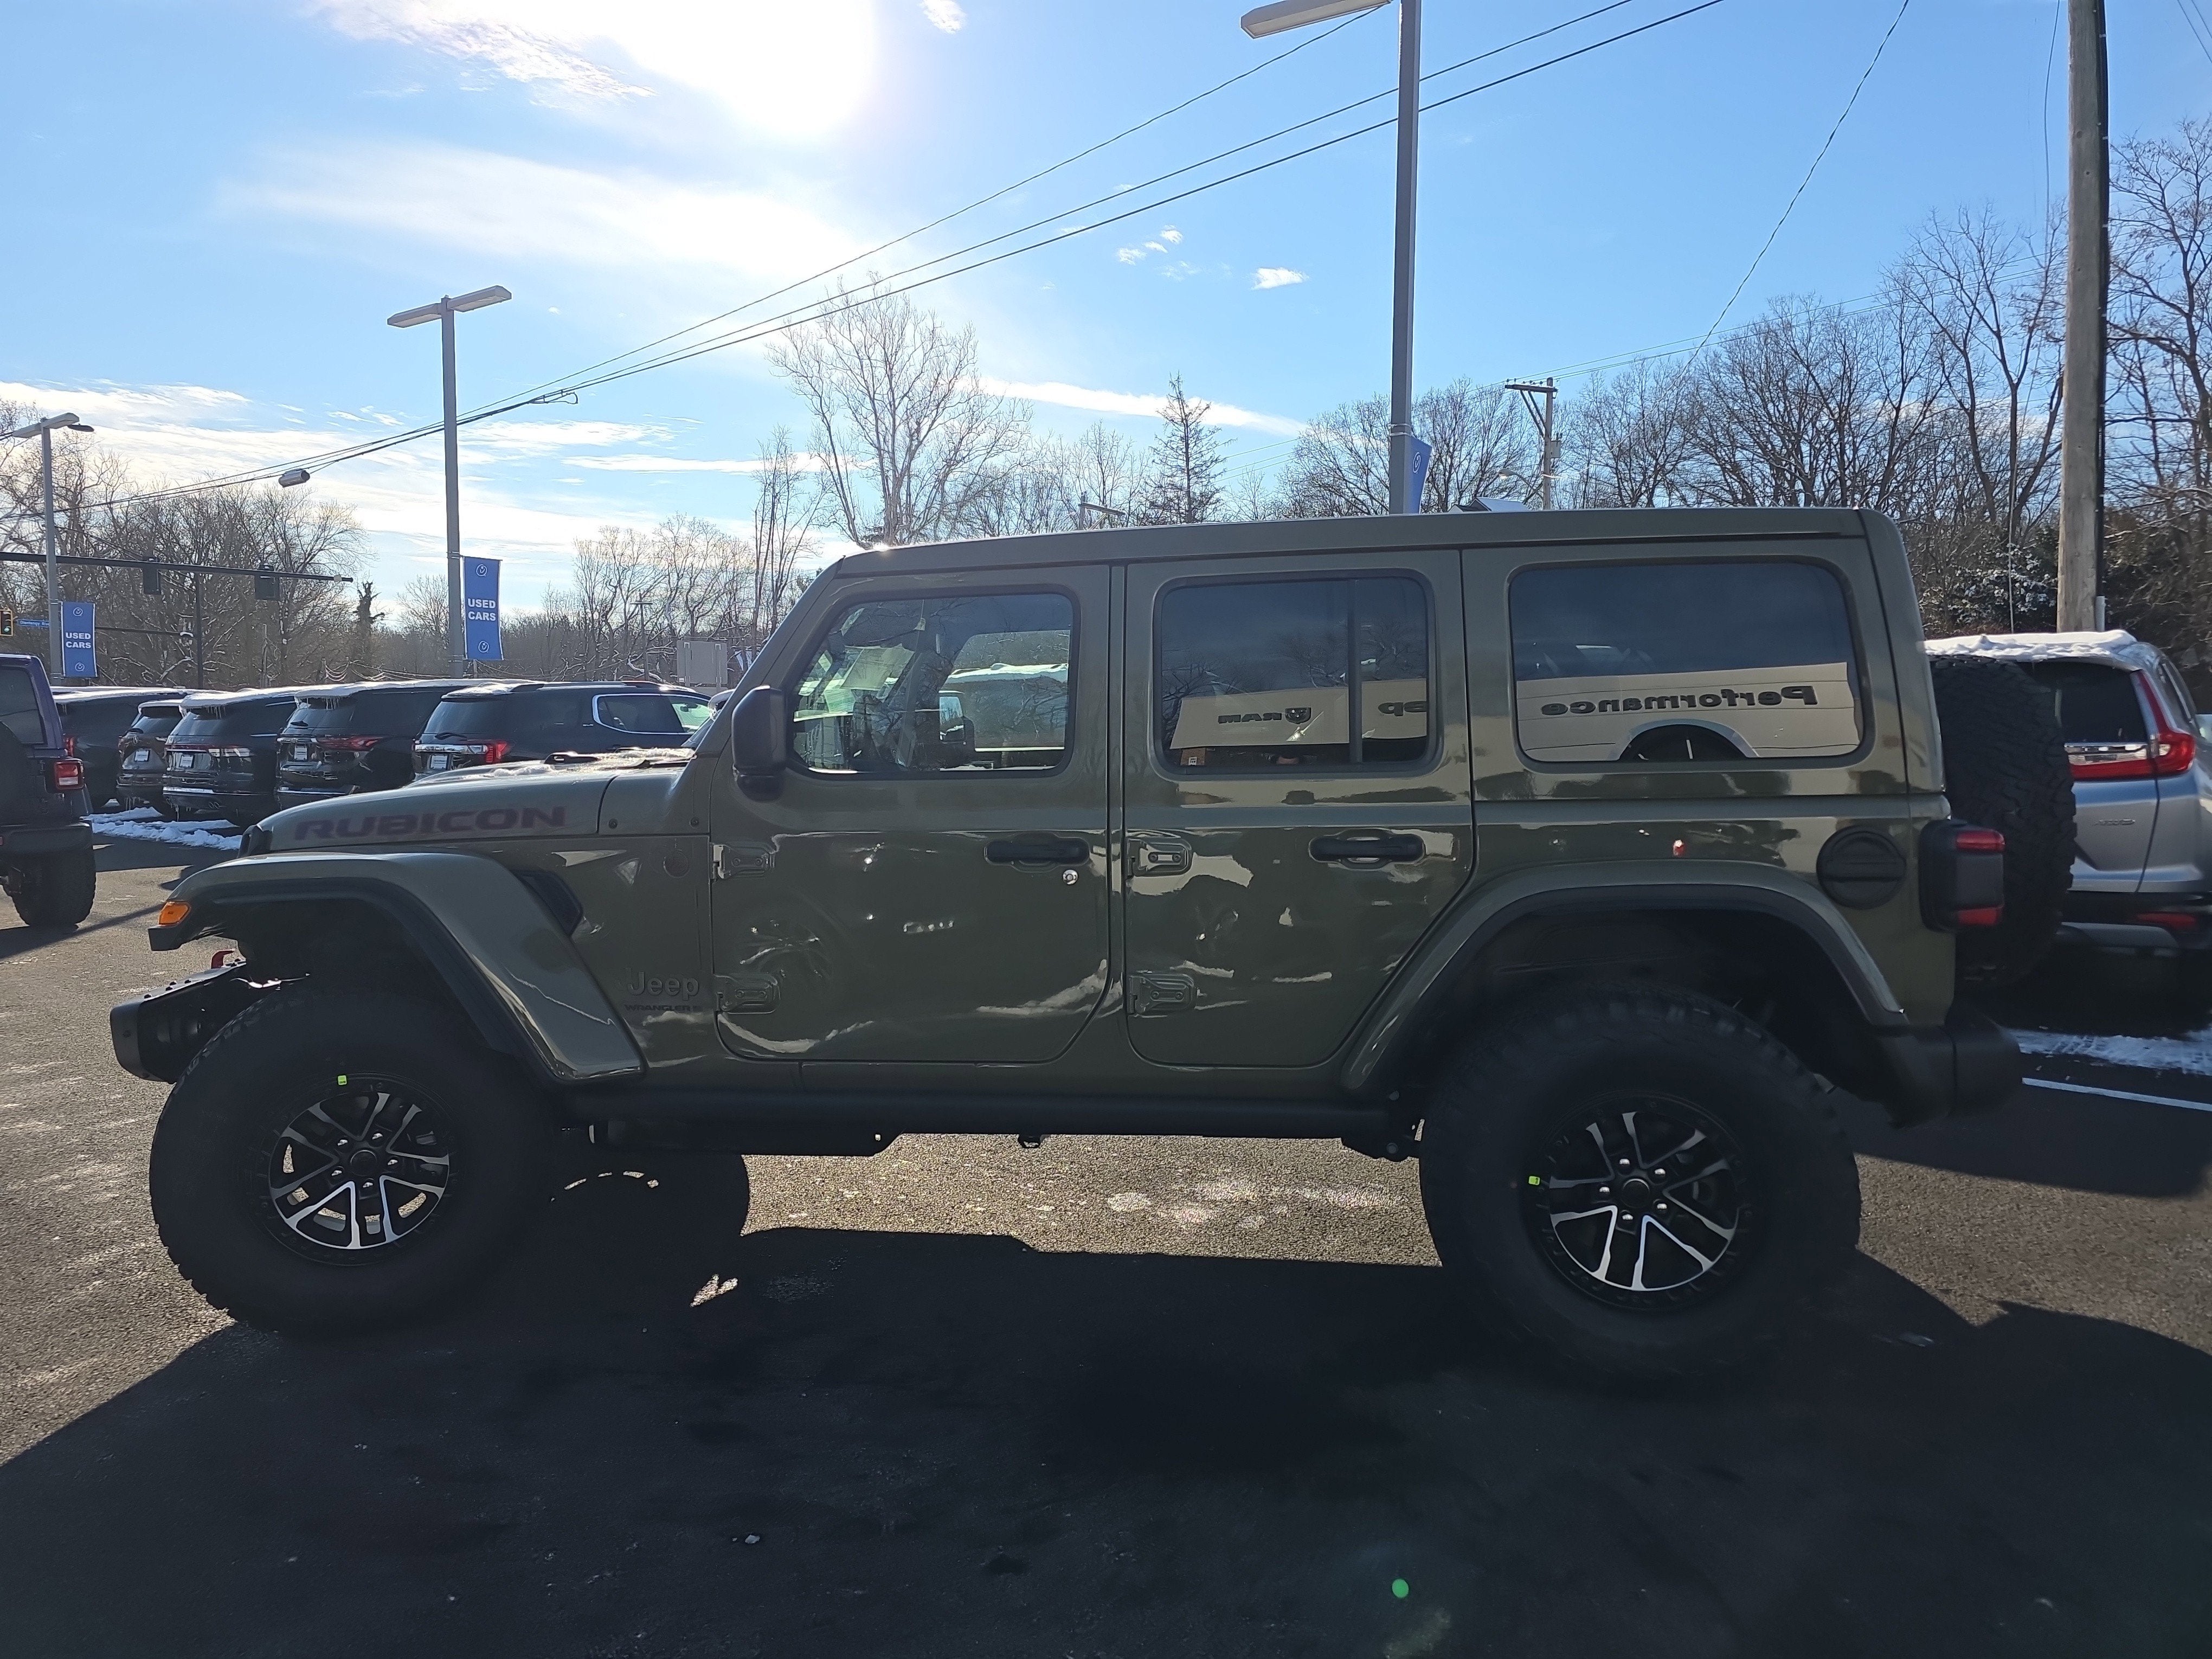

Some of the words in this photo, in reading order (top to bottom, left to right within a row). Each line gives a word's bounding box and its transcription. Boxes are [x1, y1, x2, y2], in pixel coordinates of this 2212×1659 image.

[467, 598, 496, 609] USED
[468, 611, 496, 621] CARS
[294, 806, 567, 841] RUBICON
[627, 970, 699, 1001] Jeep
